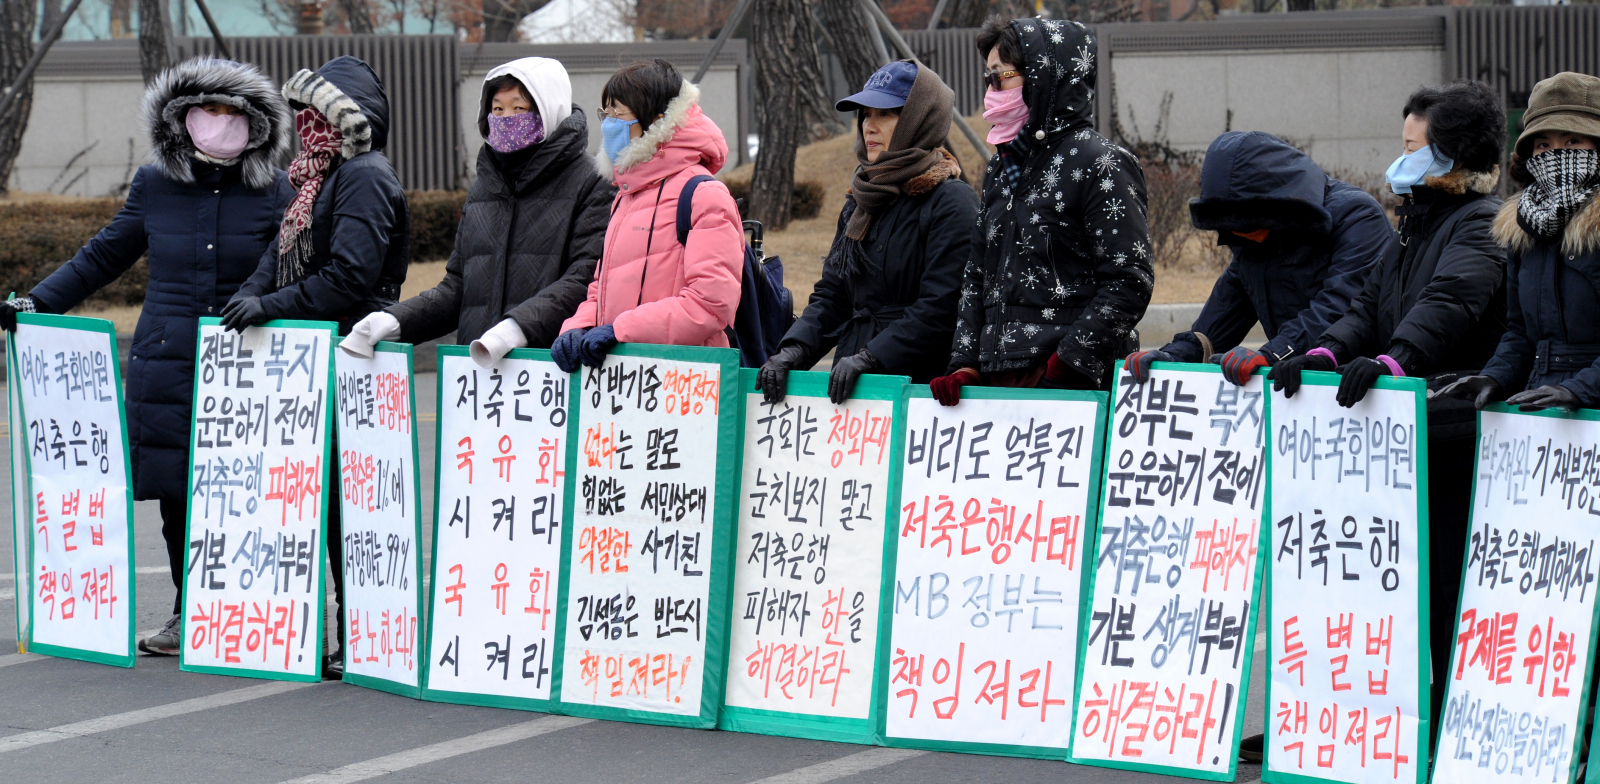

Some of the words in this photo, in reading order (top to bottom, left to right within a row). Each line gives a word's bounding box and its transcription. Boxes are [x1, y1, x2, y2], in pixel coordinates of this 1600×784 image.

[22, 346, 49, 397] 여야
[55, 350, 112, 402] 국회의원
[201, 333, 254, 388] 정부는
[264, 333, 318, 392] 복지
[585, 362, 662, 415] 상반기중
[663, 366, 720, 416] 영업정지
[196, 395, 270, 448] 운운하기
[274, 388, 322, 445] 전에
[339, 370, 374, 430] 여의도를
[376, 372, 411, 434] 점령하라
[456, 369, 566, 427] 저축은행
[1115, 376, 1199, 446] 정부는
[1209, 380, 1265, 448] 복지
[30, 418, 109, 474] 저축은행
[584, 422, 633, 470] 없다는
[647, 427, 680, 470] 말로
[757, 401, 818, 461] 국회는
[827, 408, 892, 468] 청와대
[908, 416, 993, 483] 비리로
[1005, 417, 1084, 488] 얼룩진
[1278, 416, 1322, 480] 여야
[1325, 415, 1414, 492] 국회의원
[192, 451, 263, 527] 저축은행
[265, 455, 321, 526] 피해자
[582, 474, 626, 516] 힘없는
[640, 482, 706, 524] 서민상대
[750, 467, 827, 527] 눈치보지
[839, 479, 872, 531] 말고
[1109, 447, 1206, 507] 운운하기
[1208, 446, 1266, 509] 전에
[188, 529, 226, 590] 기본
[231, 527, 316, 595] 생계부터
[345, 530, 384, 587] 저항하는
[386, 533, 410, 591] 99%
[579, 526, 633, 574] 악랄한
[641, 527, 703, 577] 사기친
[747, 531, 830, 584] 저축은행
[902, 495, 1079, 570] 저축은행사태
[1098, 514, 1195, 596] 저축은행
[1190, 517, 1257, 593] 피해자
[1277, 509, 1400, 591] 저축은행
[577, 595, 638, 641] 김석동은
[654, 596, 700, 641] 반드시
[744, 587, 811, 637] 피해자
[821, 587, 865, 647] 한을
[895, 572, 950, 620] MB
[962, 573, 1063, 632] 정부는
[191, 599, 309, 670] 해결하라!
[349, 607, 417, 671] 분노하라!
[1088, 598, 1135, 667] 기본
[1143, 594, 1249, 676] 생계부터
[1455, 608, 1519, 685] 구제를
[1523, 616, 1576, 698] 위한
[745, 640, 850, 707] 해결하라
[1082, 678, 1234, 765] 해결하라!
